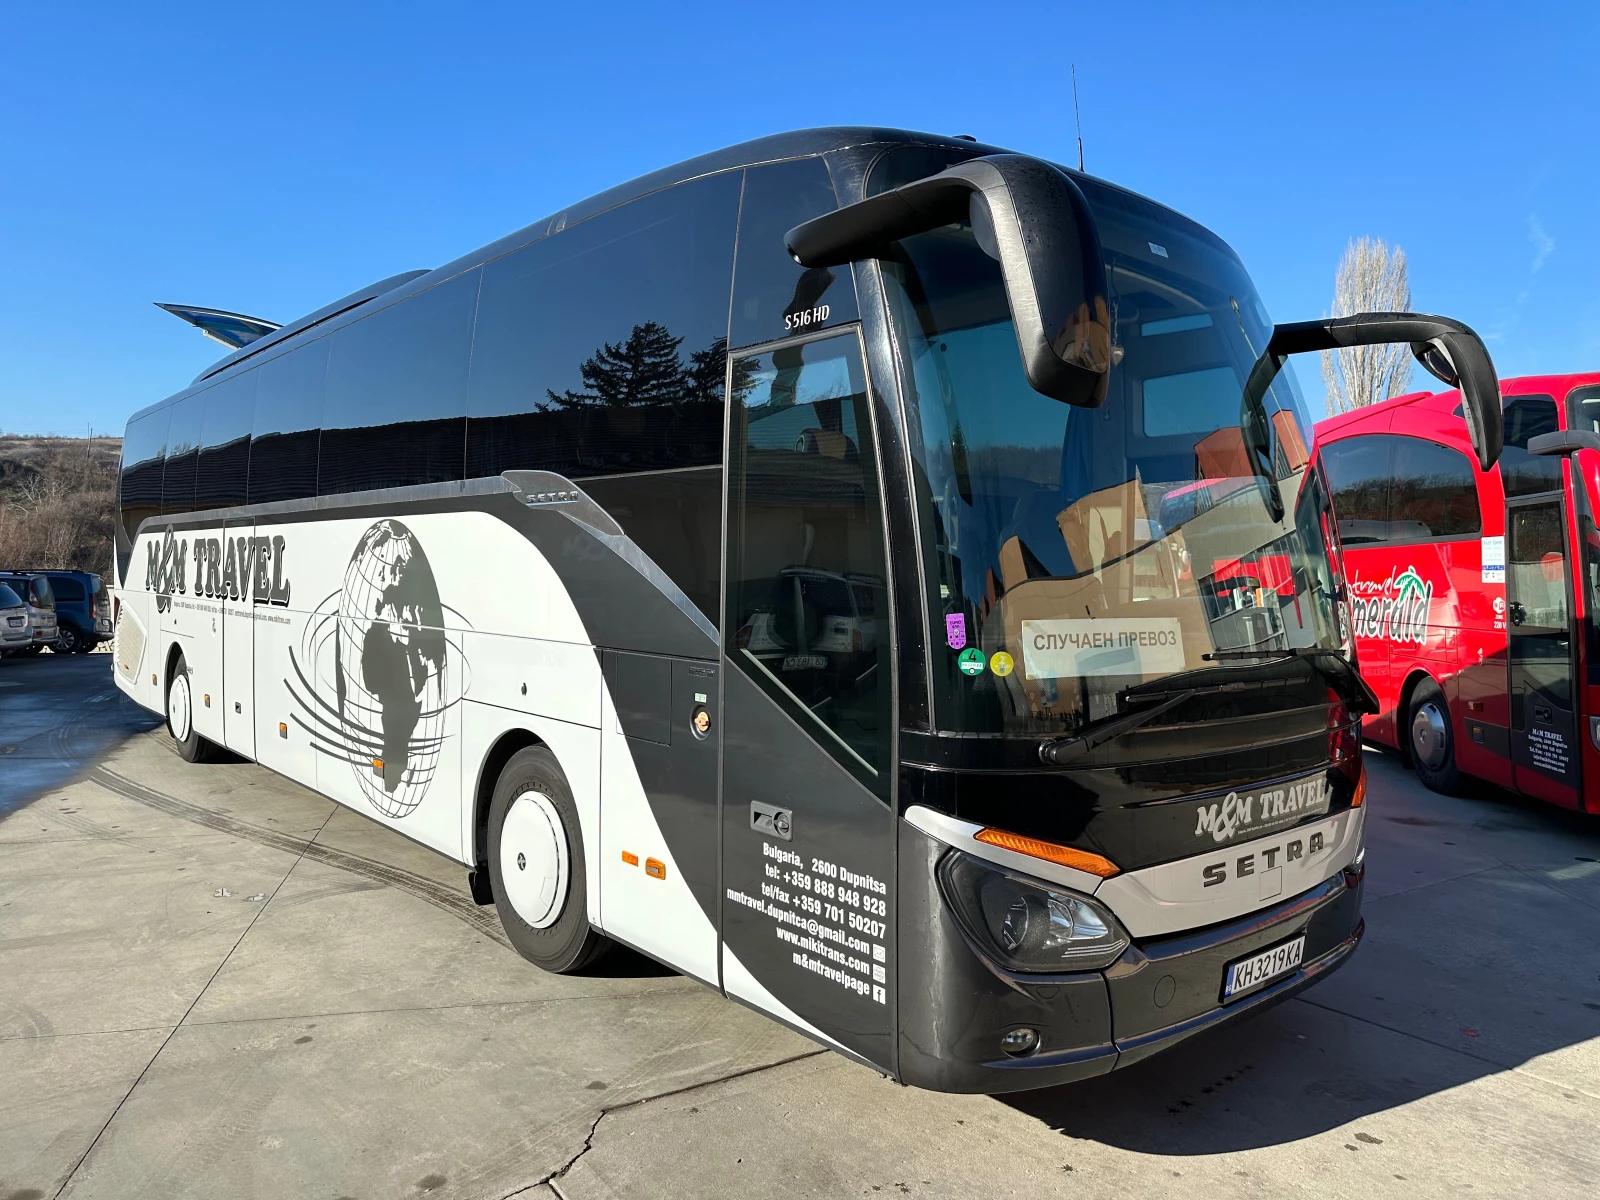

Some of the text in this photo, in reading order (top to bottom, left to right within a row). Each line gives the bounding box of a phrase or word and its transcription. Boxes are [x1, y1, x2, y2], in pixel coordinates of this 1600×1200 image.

[784, 304, 830, 330] S 516 HD
[526, 490, 579, 504] SETRA
[145, 523, 290, 614] M&M TRAVEL
[1353, 565, 1397, 595] travel
[968, 649, 977, 662] 4
[1033, 630, 1177, 650] СЛУЧАЕН ПРЕВОЗ
[1195, 792, 1254, 842] M&M
[1260, 779, 1325, 820] TRAVEL
[763, 842, 887, 895] Bulgaria, 2600 Dupnitsa
[1202, 831, 1324, 888] SETRA
[761, 882, 887, 939] tel/fax +359 701 50207
[765, 863, 887, 917] tel: +359 888 948 928
[727, 888, 870, 955] mmtravel.dupnitca@gmail.com
[776, 926, 870, 976] www.mikitrans.com
[792, 952, 870, 995] m&mtravelpage
[1233, 940, 1301, 991] KH3219KA
